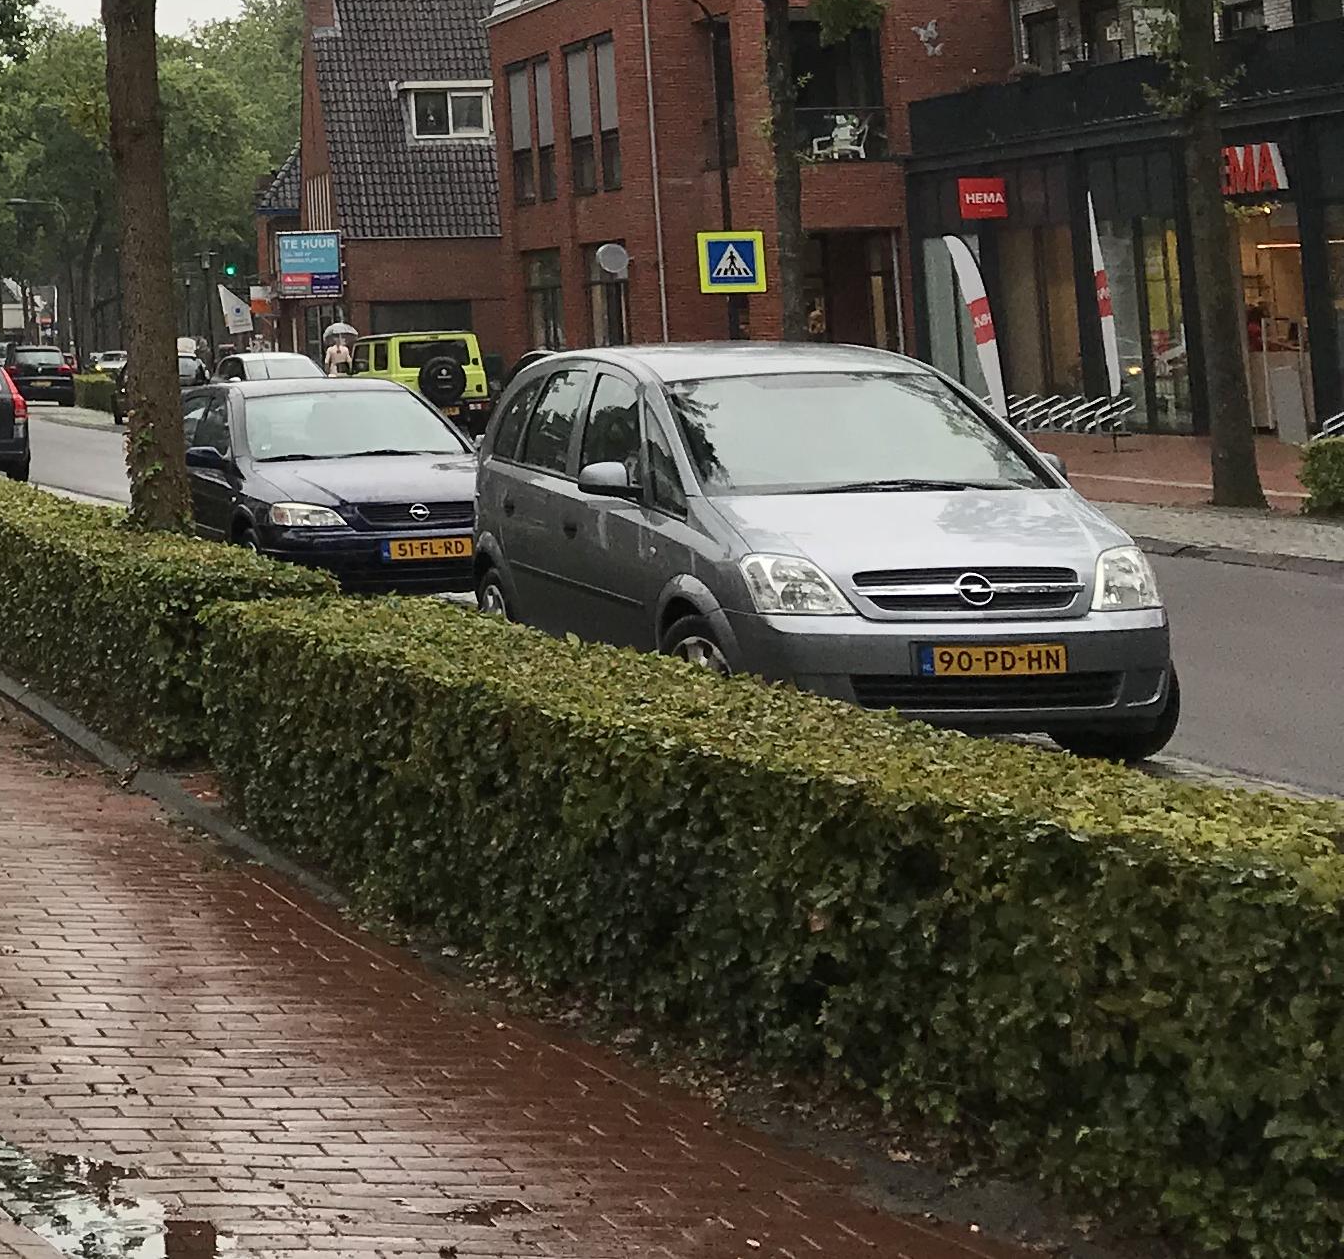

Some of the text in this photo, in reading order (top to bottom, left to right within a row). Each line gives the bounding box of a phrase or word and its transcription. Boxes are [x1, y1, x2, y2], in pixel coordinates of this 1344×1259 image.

[1220, 142, 1282, 194] EMA
[965, 193, 1004, 205] HEMA
[283, 238, 335, 249] TE HUUR
[398, 540, 465, 557] 51-FL-RD
[938, 649, 1061, 672] 90-PD-HN
